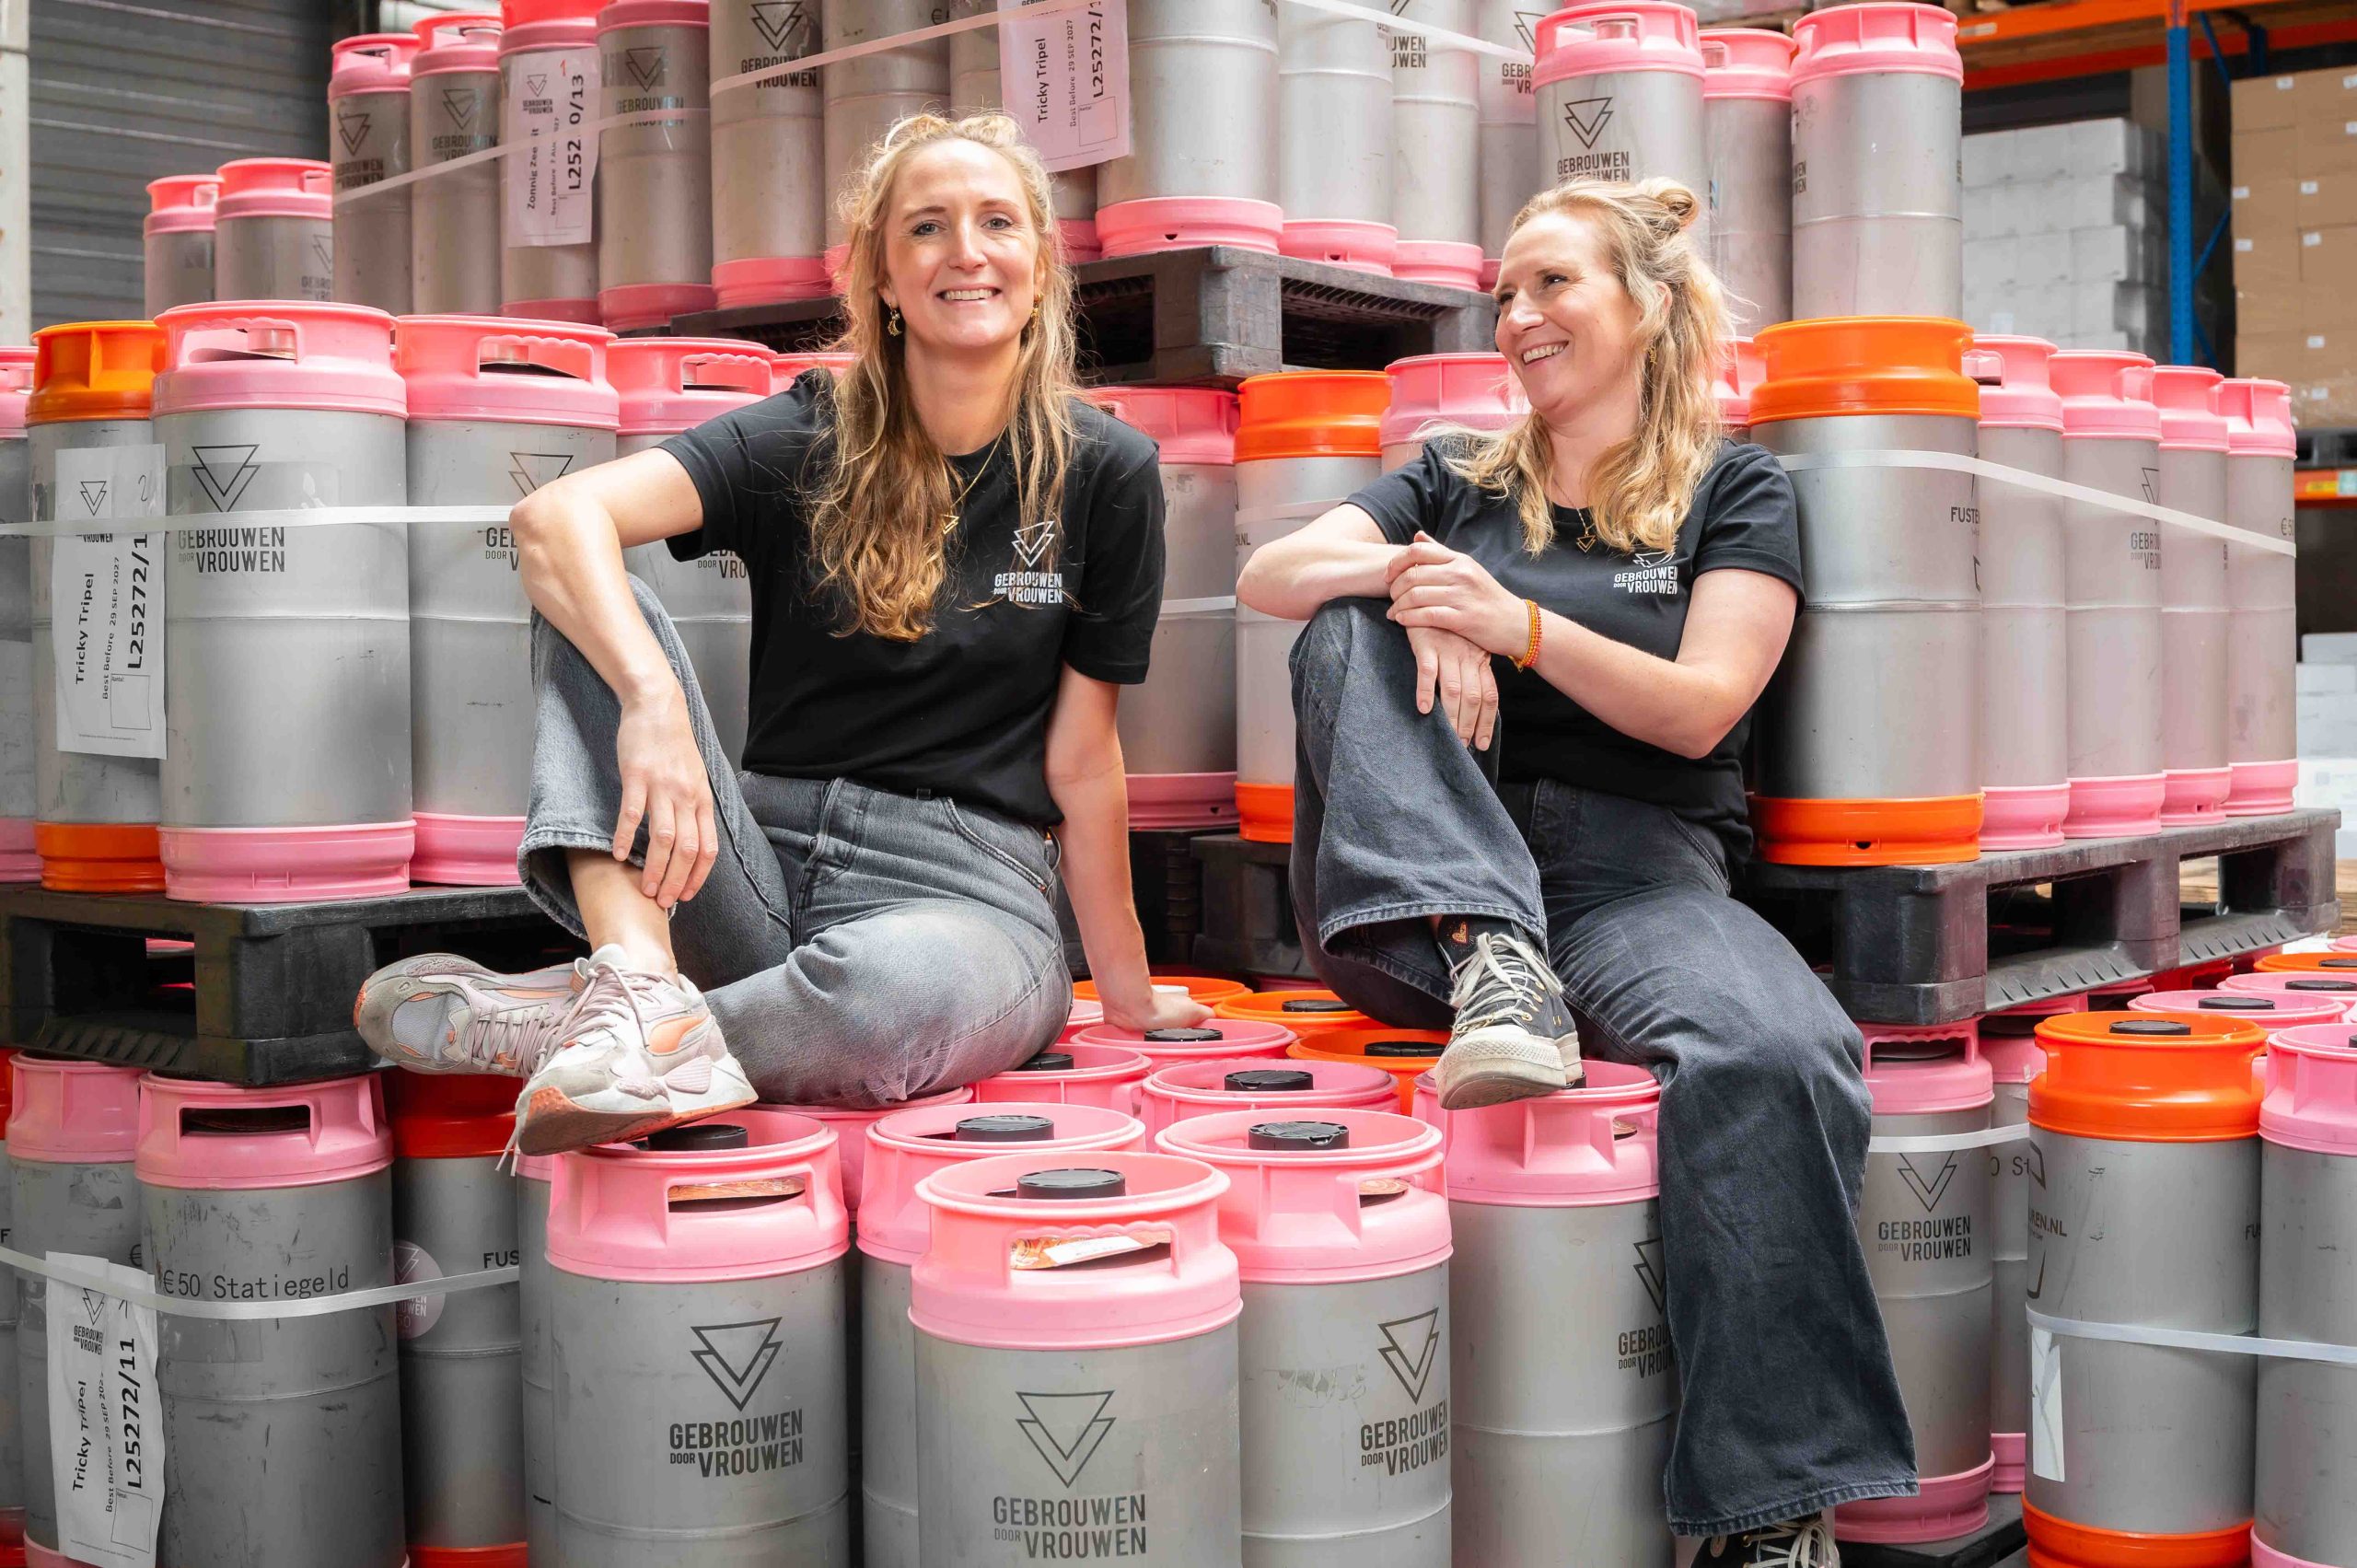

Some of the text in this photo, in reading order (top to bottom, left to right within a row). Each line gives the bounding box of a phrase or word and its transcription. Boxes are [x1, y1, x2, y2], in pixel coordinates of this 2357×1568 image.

[1035, 38, 1050, 123] Tricky Tripel
[568, 75, 585, 190] L2520/13
[527, 128, 540, 210] Zonnig Zeeit
[1557, 151, 1629, 175] GEBROUWEN
[179, 527, 284, 550] GEBROUWEN
[196, 551, 284, 573] VROUWEN
[485, 551, 506, 560] DOOR
[697, 560, 716, 568] DOOR
[994, 572, 1062, 587] GEBROUWEN
[1614, 565, 1678, 583] GEBROUWEN
[1627, 579, 1678, 595] VROUWEN
[1008, 587, 1063, 603] VROUWEN
[75, 574, 94, 684] Tricky Tripel
[103, 633, 114, 671] Before
[109, 612, 117, 626] 29
[1878, 1215, 1970, 1240] GEBROUWEN
[1878, 1237, 1971, 1261] DOOR VROUWEN
[163, 1264, 349, 1299] €50 Statiegeld
[1619, 1357, 1636, 1369] DOOR
[119, 1338, 141, 1489] L25272/11
[669, 1409, 803, 1449] GEBROUWEN
[1361, 1398, 1447, 1451] GEBROUWEN
[73, 1436, 91, 1492] Tricky
[669, 1437, 803, 1478] DOOR VROUWEN
[1362, 1426, 1448, 1476] DOOR VROUWEN
[106, 1488, 114, 1513] Best
[993, 1493, 1146, 1527] GEBROUWEN
[994, 1527, 1147, 1559] DOOR VROUWEN
